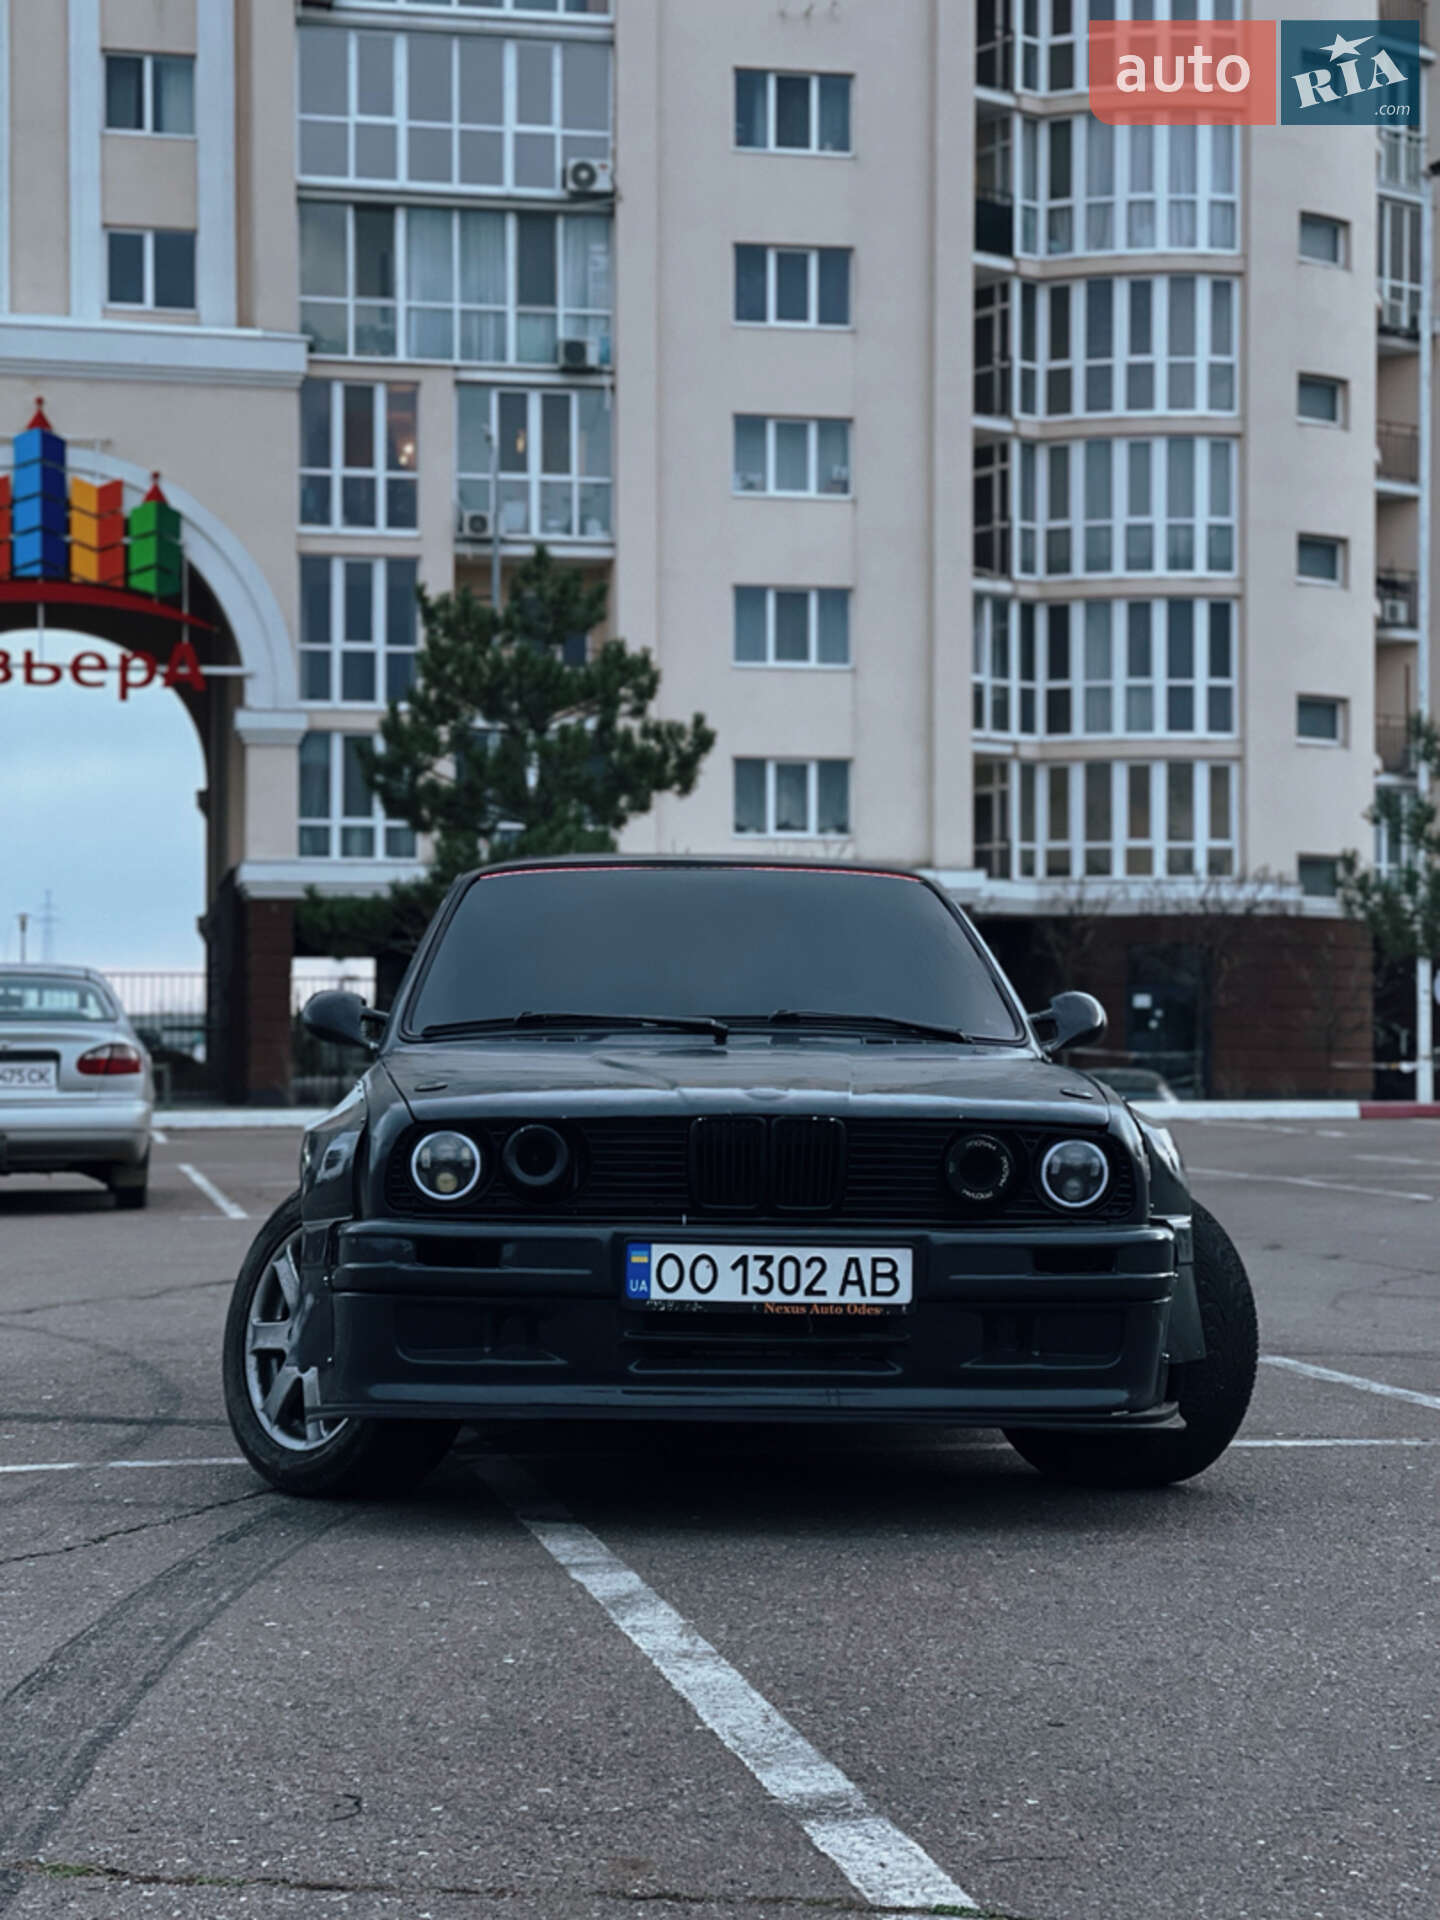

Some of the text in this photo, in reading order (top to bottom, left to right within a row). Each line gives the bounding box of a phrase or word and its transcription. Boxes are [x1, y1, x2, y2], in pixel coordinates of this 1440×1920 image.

[730, 1254, 828, 1297] 1302
[838, 1256, 900, 1297] AB
[630, 1279, 648, 1293] UA
[763, 1302, 807, 1315] Nexus
[809, 1303, 844, 1316] Auto
